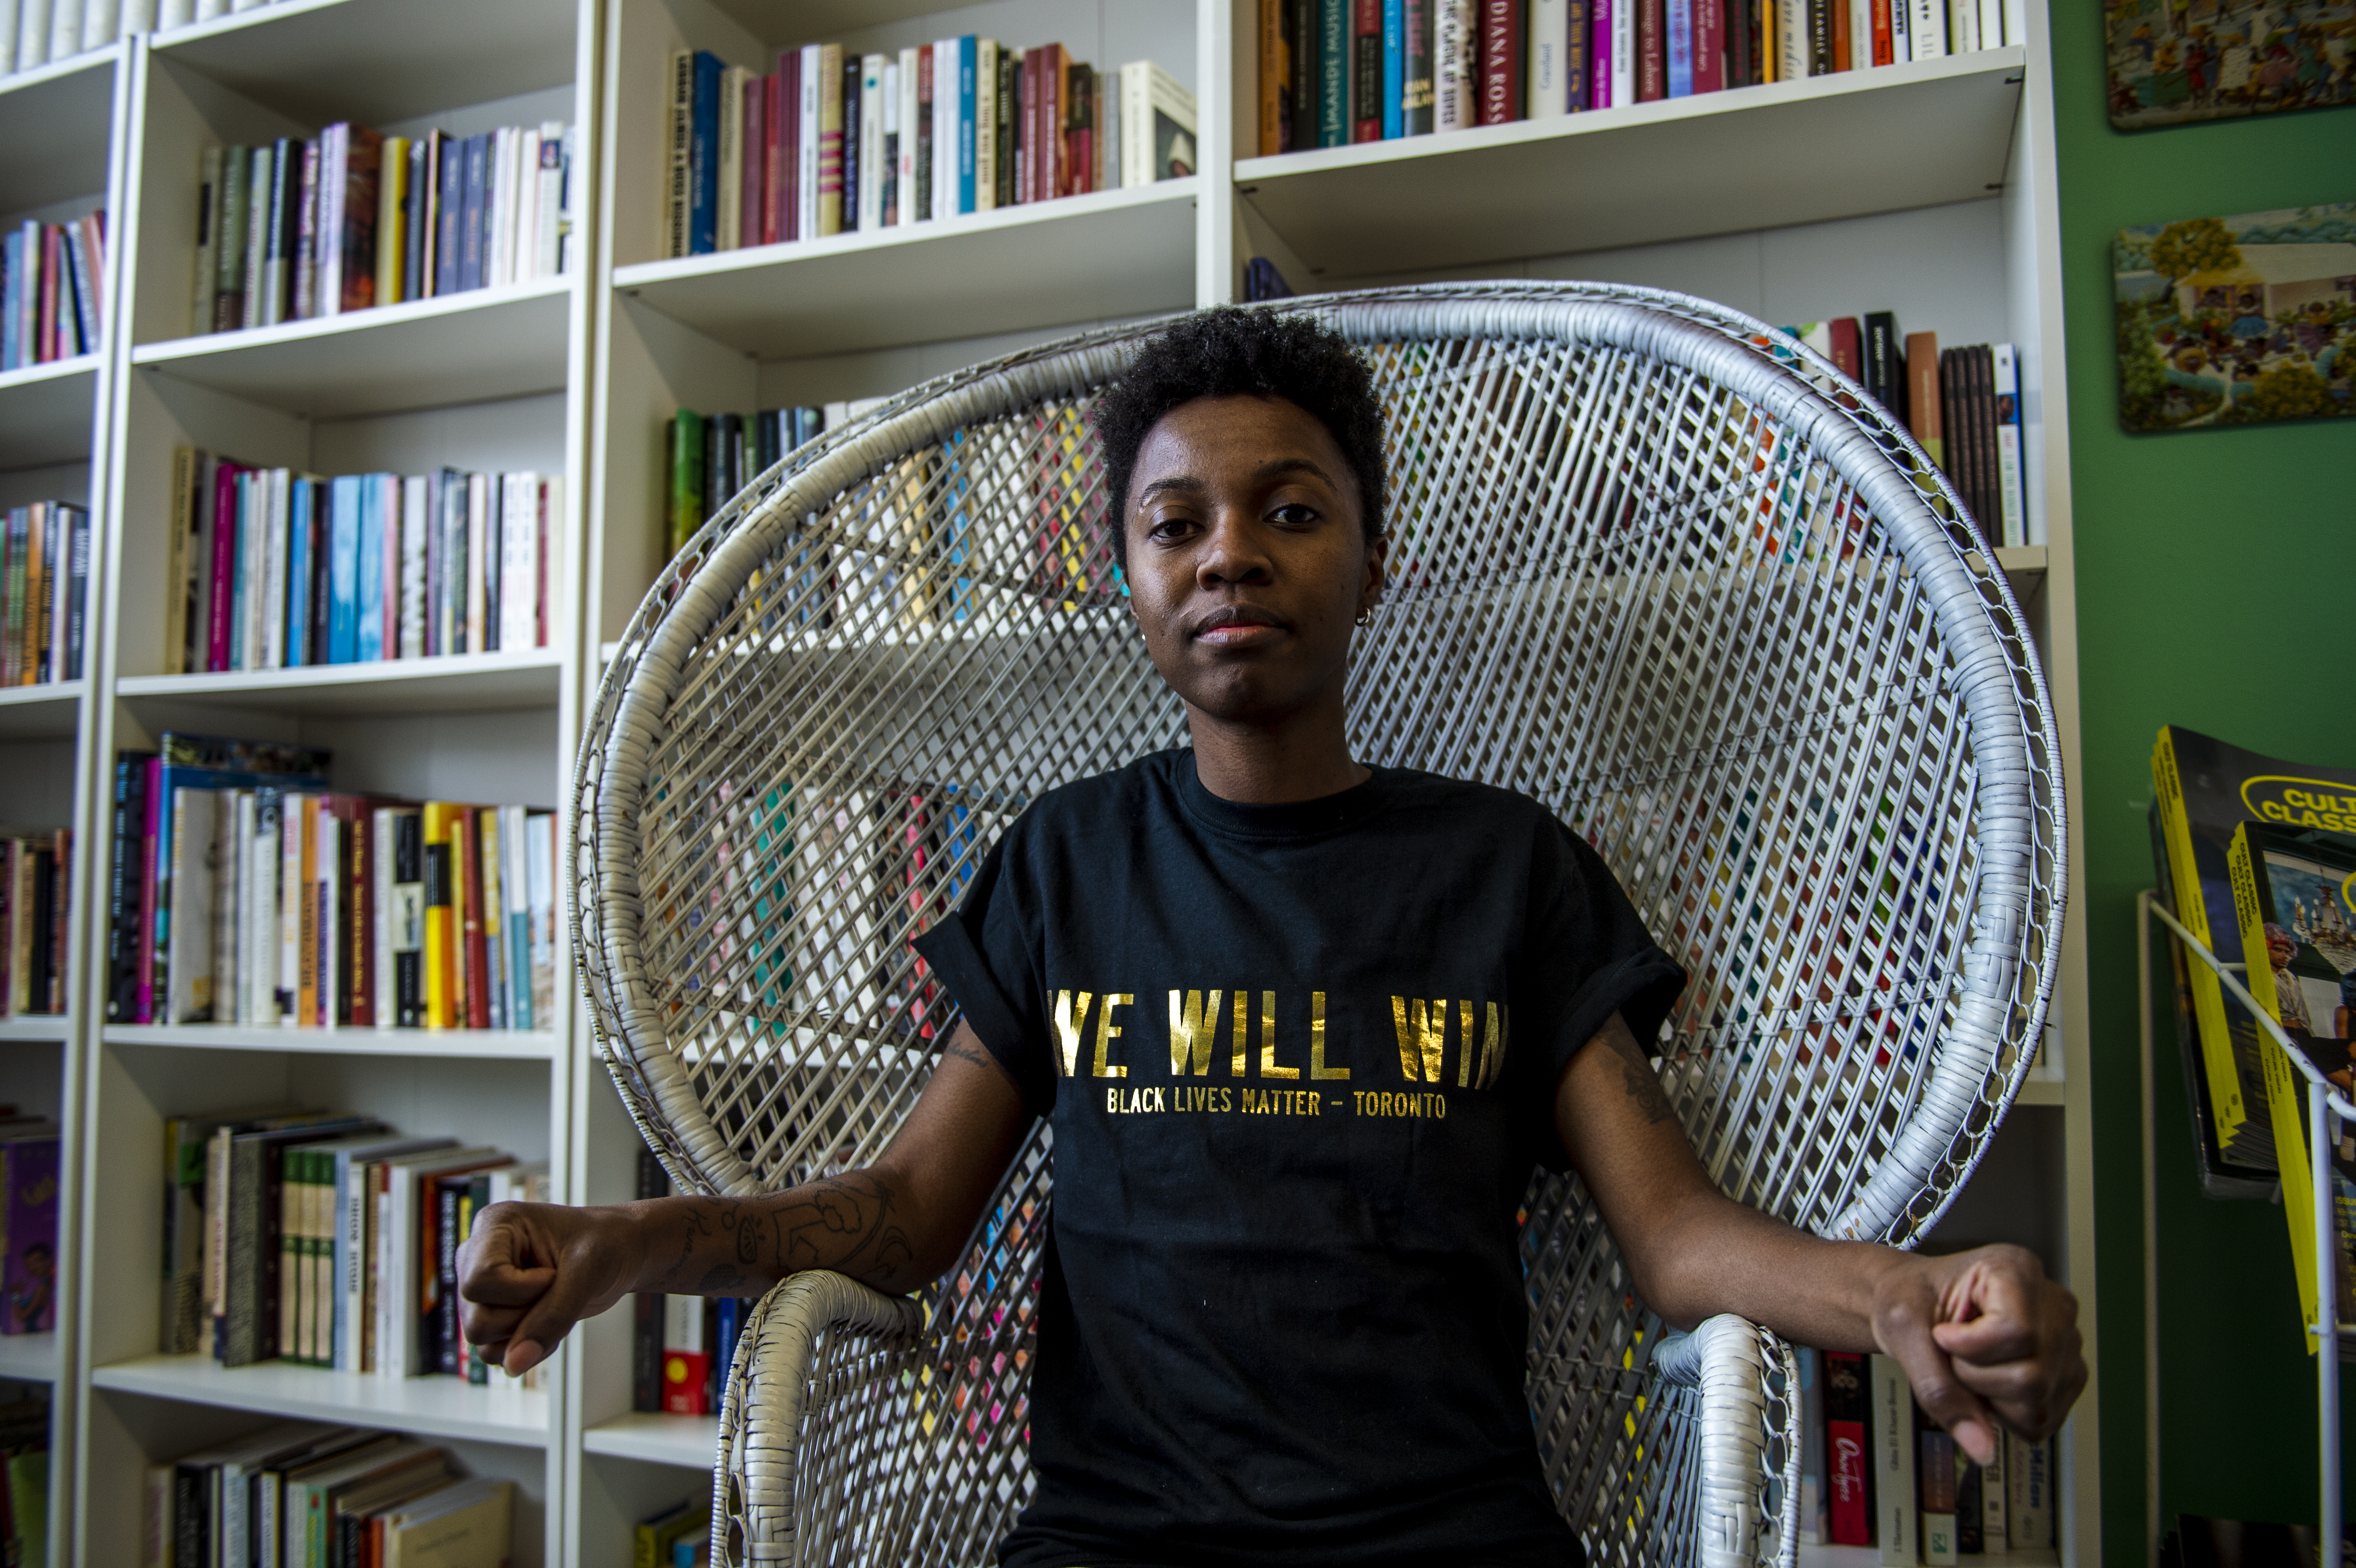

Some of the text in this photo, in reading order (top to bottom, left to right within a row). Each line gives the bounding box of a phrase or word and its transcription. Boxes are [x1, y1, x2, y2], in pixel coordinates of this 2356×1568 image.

[1488, 2, 1508, 124] DIANA ROSS
[2240, 842, 2257, 915] CULT CLASSIC
[2241, 882, 2252, 928] CLASSIC
[2236, 893, 2248, 939] CLASSIC
[1047, 989, 1508, 1091] WE WILL WIN
[1107, 1087, 1166, 1113] BLACK
[1174, 1087, 1232, 1112] LIVES
[1242, 1088, 1321, 1116] MATTER
[1353, 1091, 1445, 1119] TORONTO
